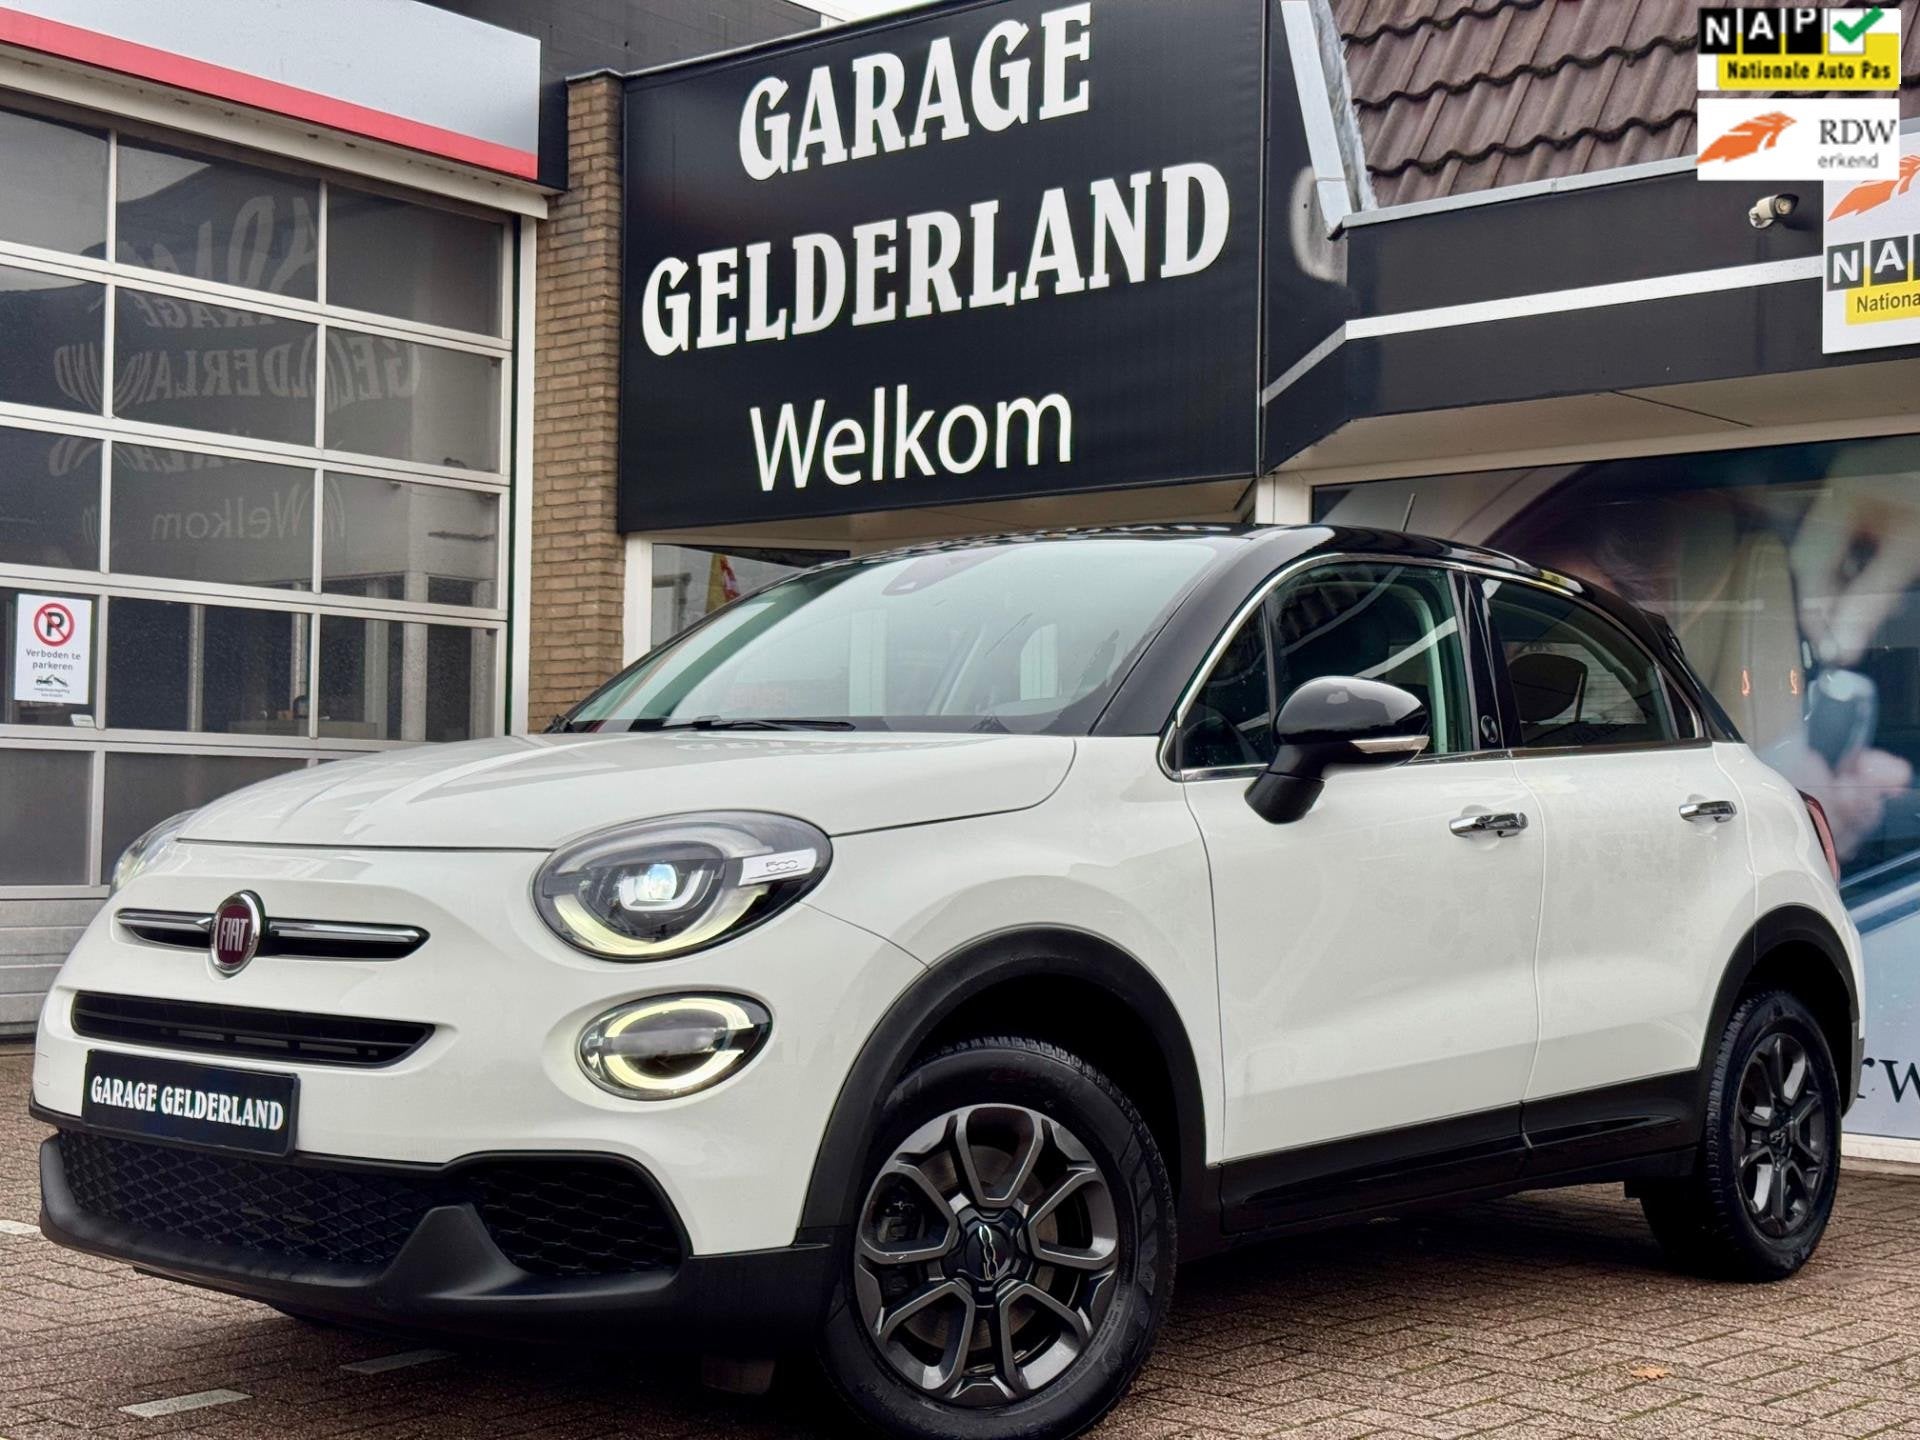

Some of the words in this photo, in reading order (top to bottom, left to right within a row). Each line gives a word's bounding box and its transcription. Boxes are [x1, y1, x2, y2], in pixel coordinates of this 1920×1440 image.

[739, 3, 1092, 181] GARAGE
[642, 163, 1230, 357] GELDERLAND
[750, 384, 1072, 491] Welkom
[26, 649, 69, 660] Verboden
[32, 661, 73, 671] parkeren
[218, 917, 249, 952] FIAT
[91, 1075, 157, 1112] GARAGE
[161, 1086, 284, 1131] GELDERLAND
